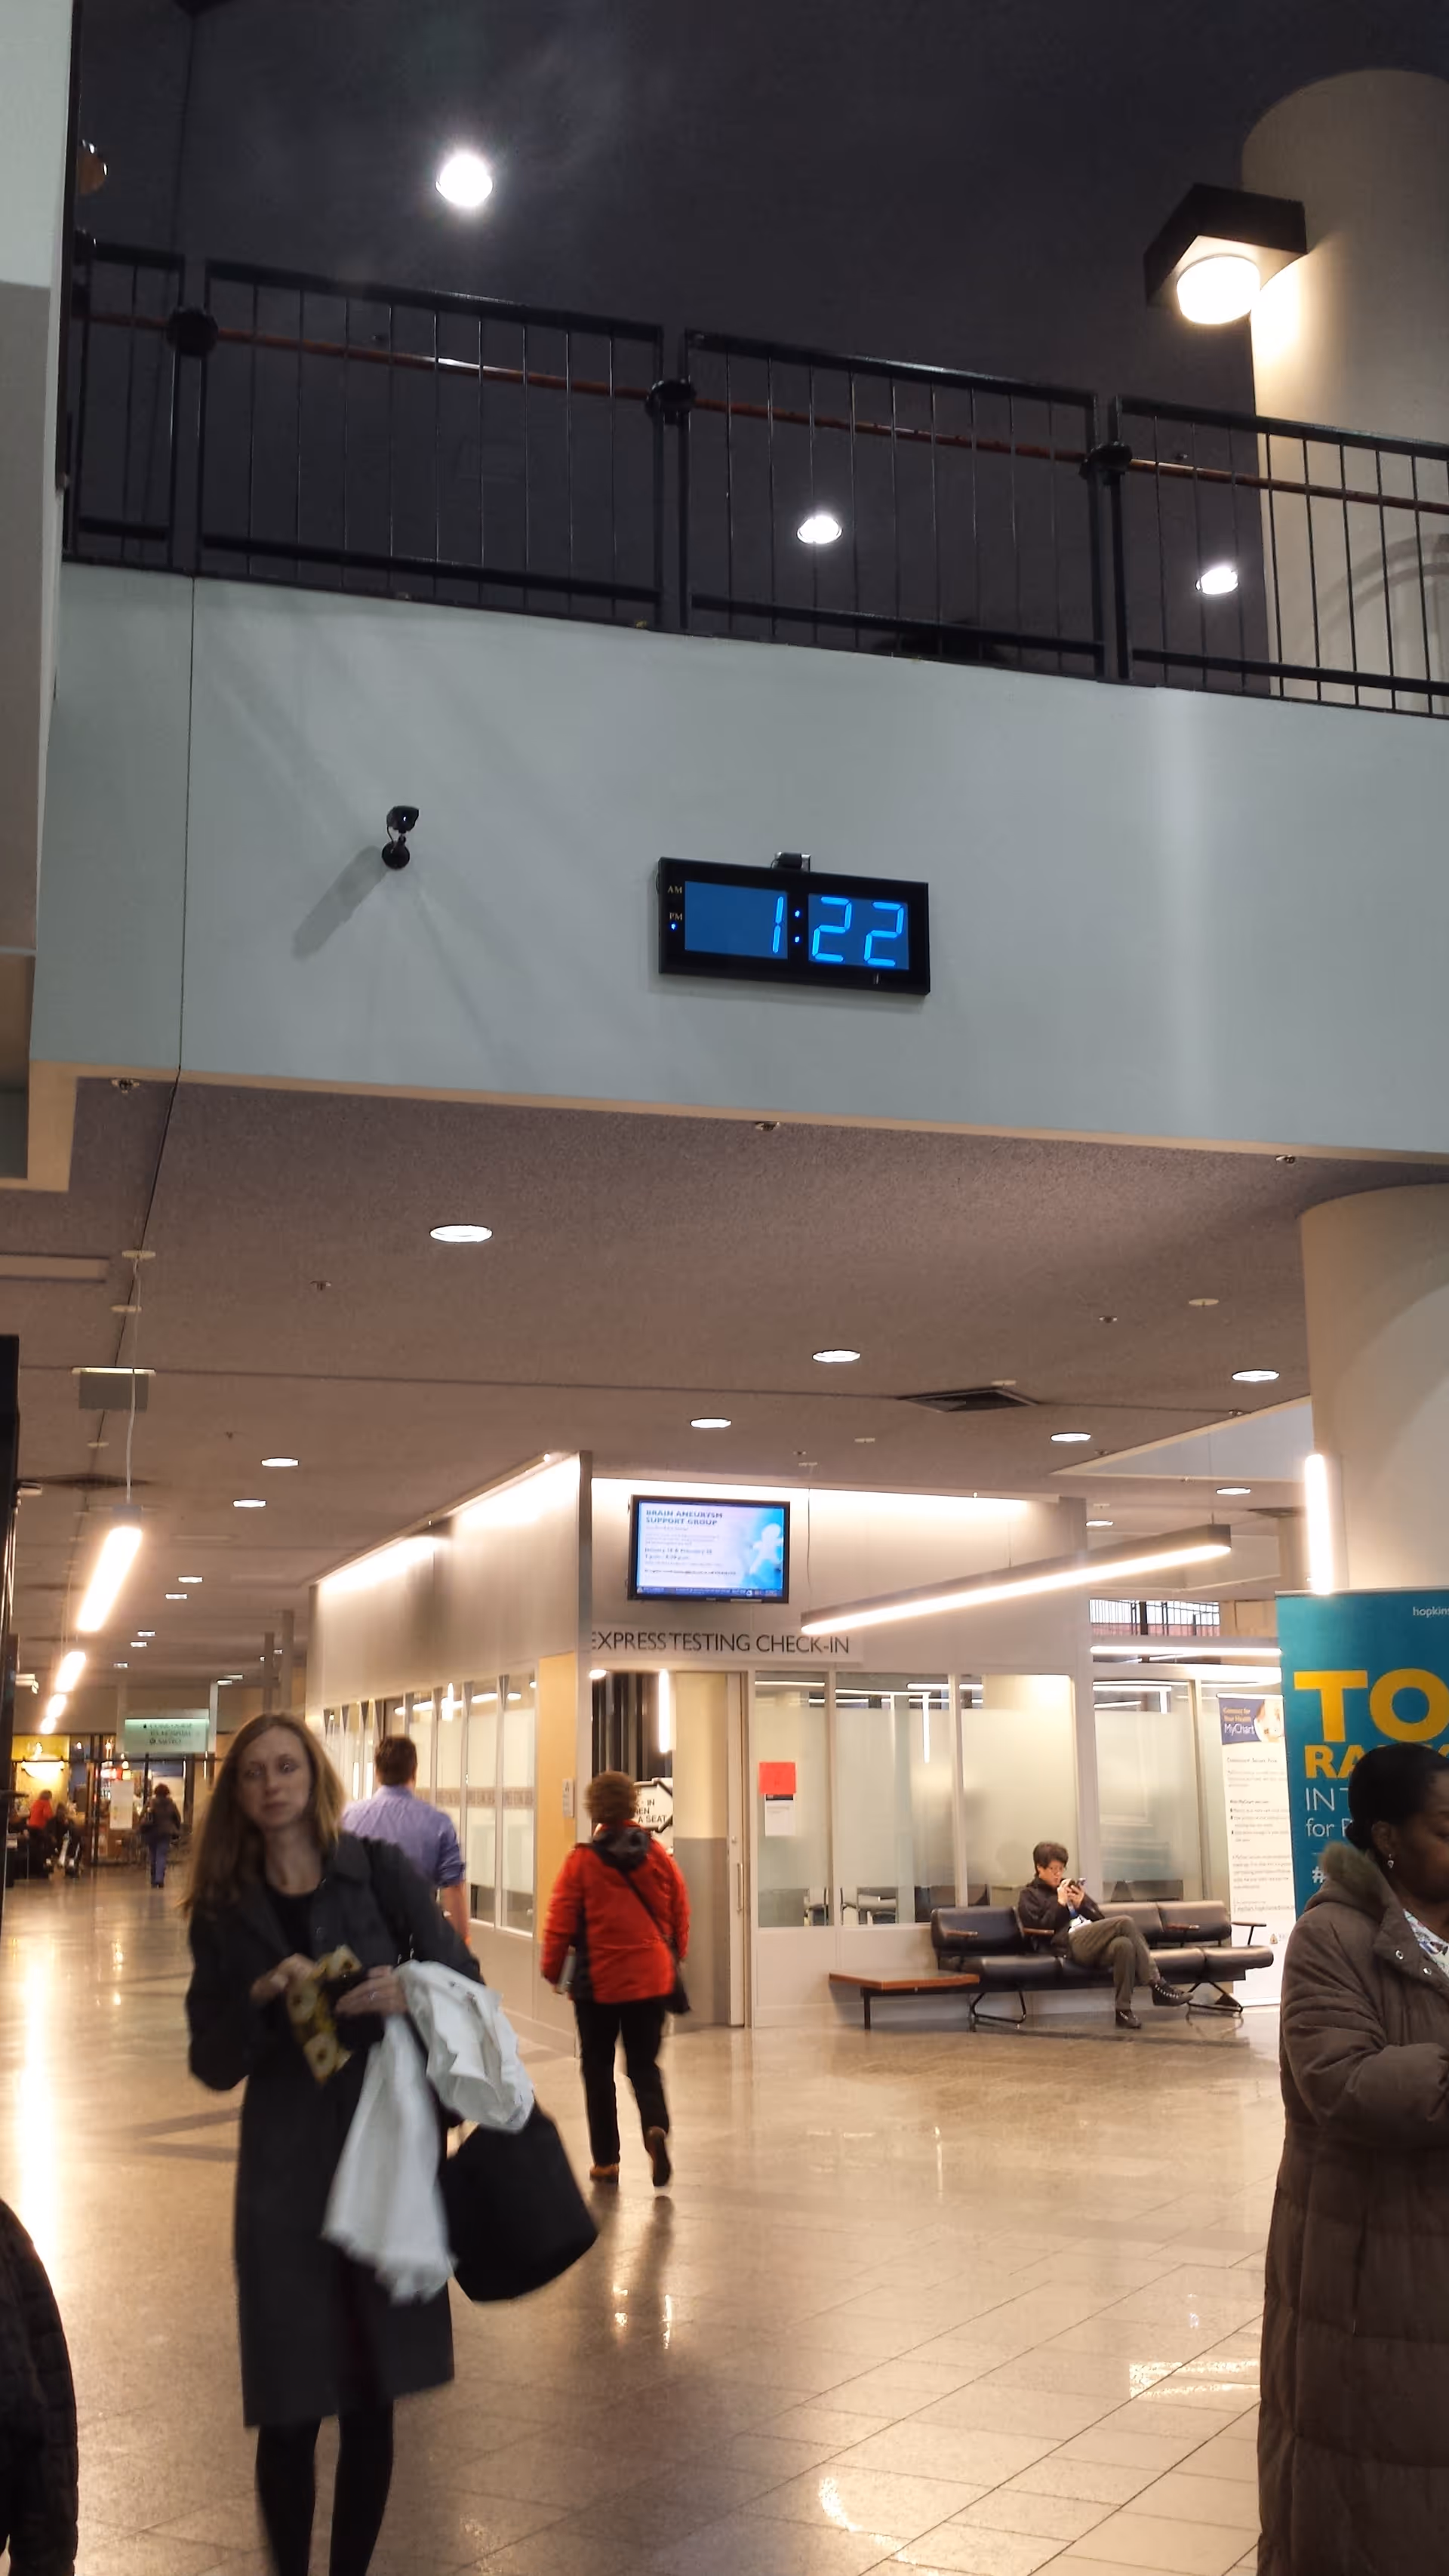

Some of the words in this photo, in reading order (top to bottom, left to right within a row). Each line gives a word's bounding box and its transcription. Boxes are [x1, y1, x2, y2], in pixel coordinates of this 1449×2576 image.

[667, 885, 683, 894] AM
[669, 912, 683, 921] PM
[773, 896, 905, 968] 1:22
[646, 1509, 674, 1518] BRAIN
[676, 1510, 723, 1519] ANEURYSM
[669, 1632, 750, 1652] TESTING
[756, 1634, 849, 1654] CHECK-IN
[1224, 1723, 1256, 1736] MyChart
[1305, 1787, 1335, 1811] IN
[1306, 1817, 1335, 1837] for
